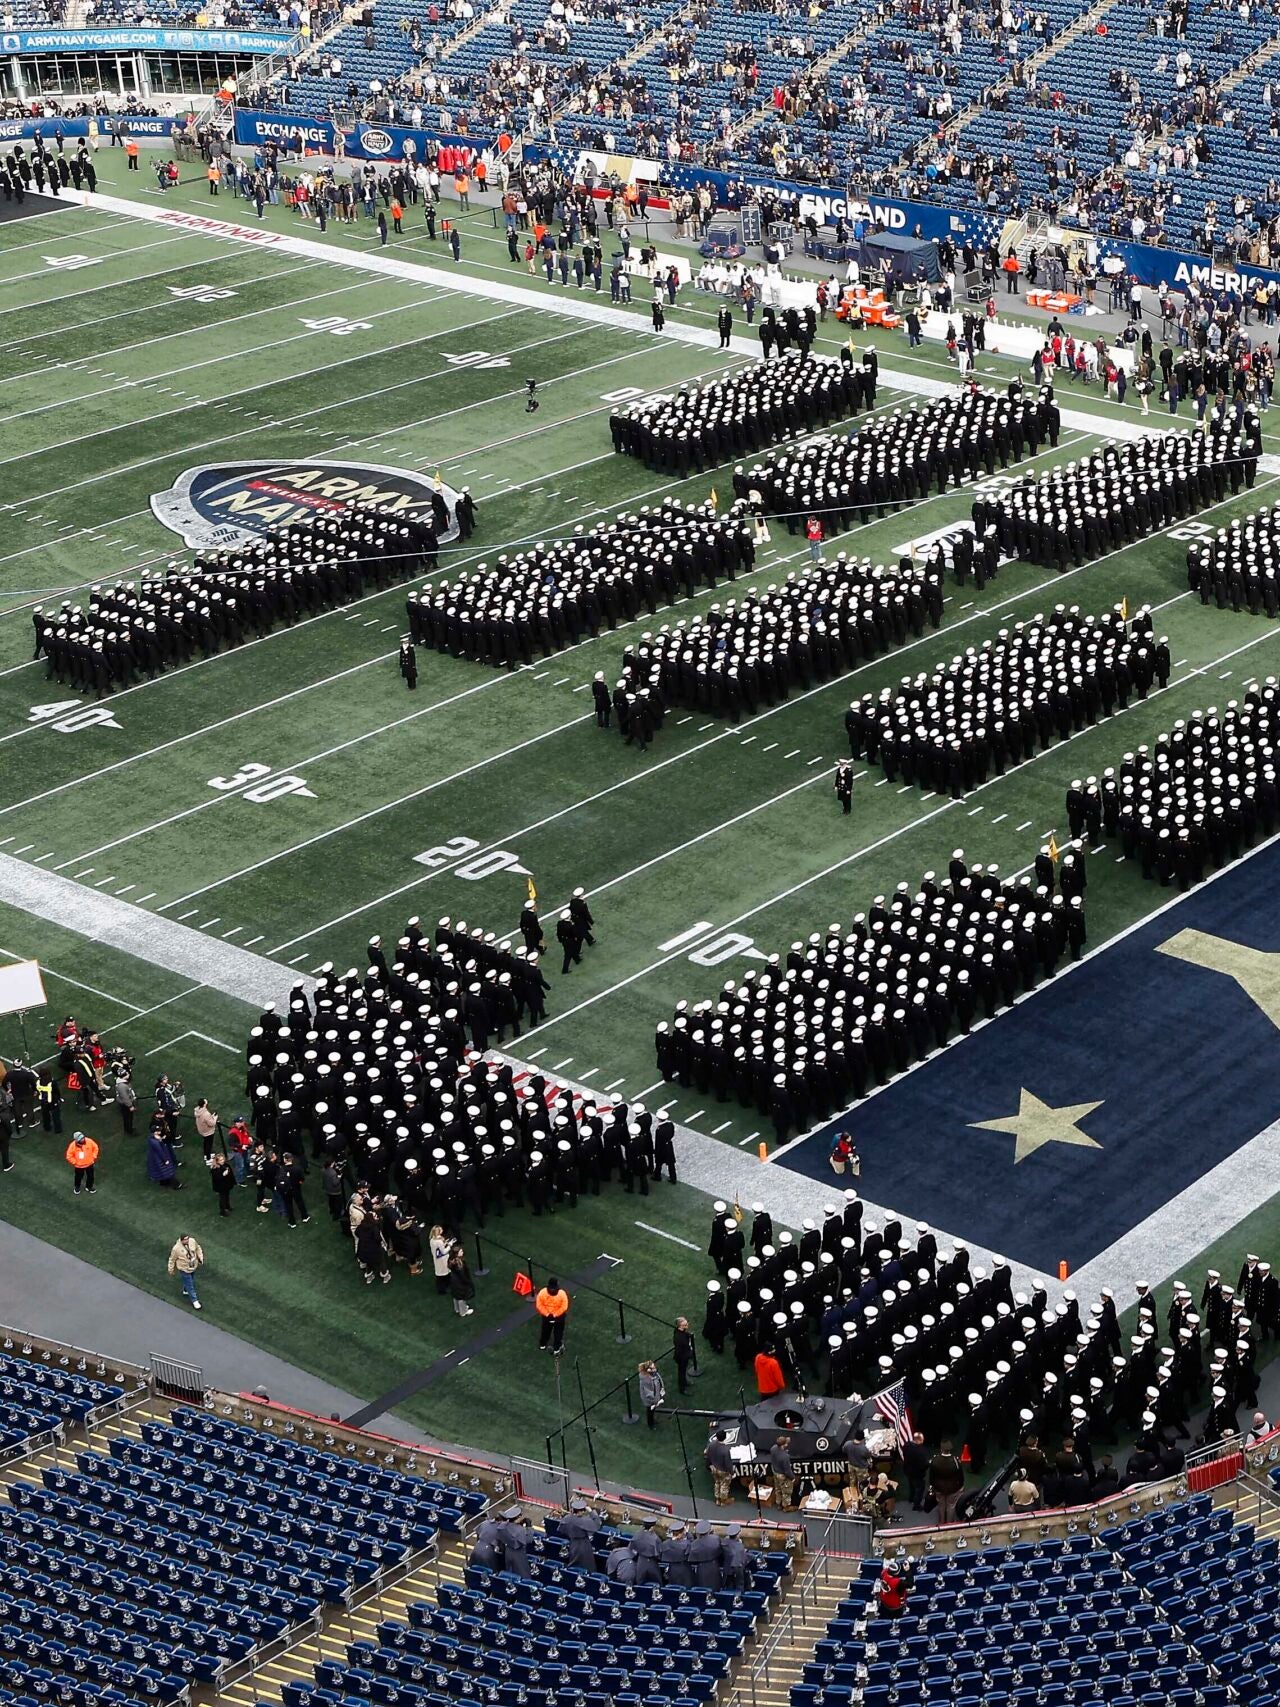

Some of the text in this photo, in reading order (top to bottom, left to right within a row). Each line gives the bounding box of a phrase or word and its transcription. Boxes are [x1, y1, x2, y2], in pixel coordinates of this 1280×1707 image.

[27, 33, 156, 46] ARMYNAVYGAME.COM
[156, 212, 291, 243] #ARMYNAVY
[171, 284, 239, 302] 20
[304, 316, 373, 336] 30
[446, 351, 511, 369] 40
[268, 470, 433, 513] ARMY
[27, 699, 115, 733] 40
[207, 763, 307, 803] 30
[412, 836, 519, 881] 20
[656, 920, 754, 967] 10
[732, 1463, 769, 1478] ARMY
